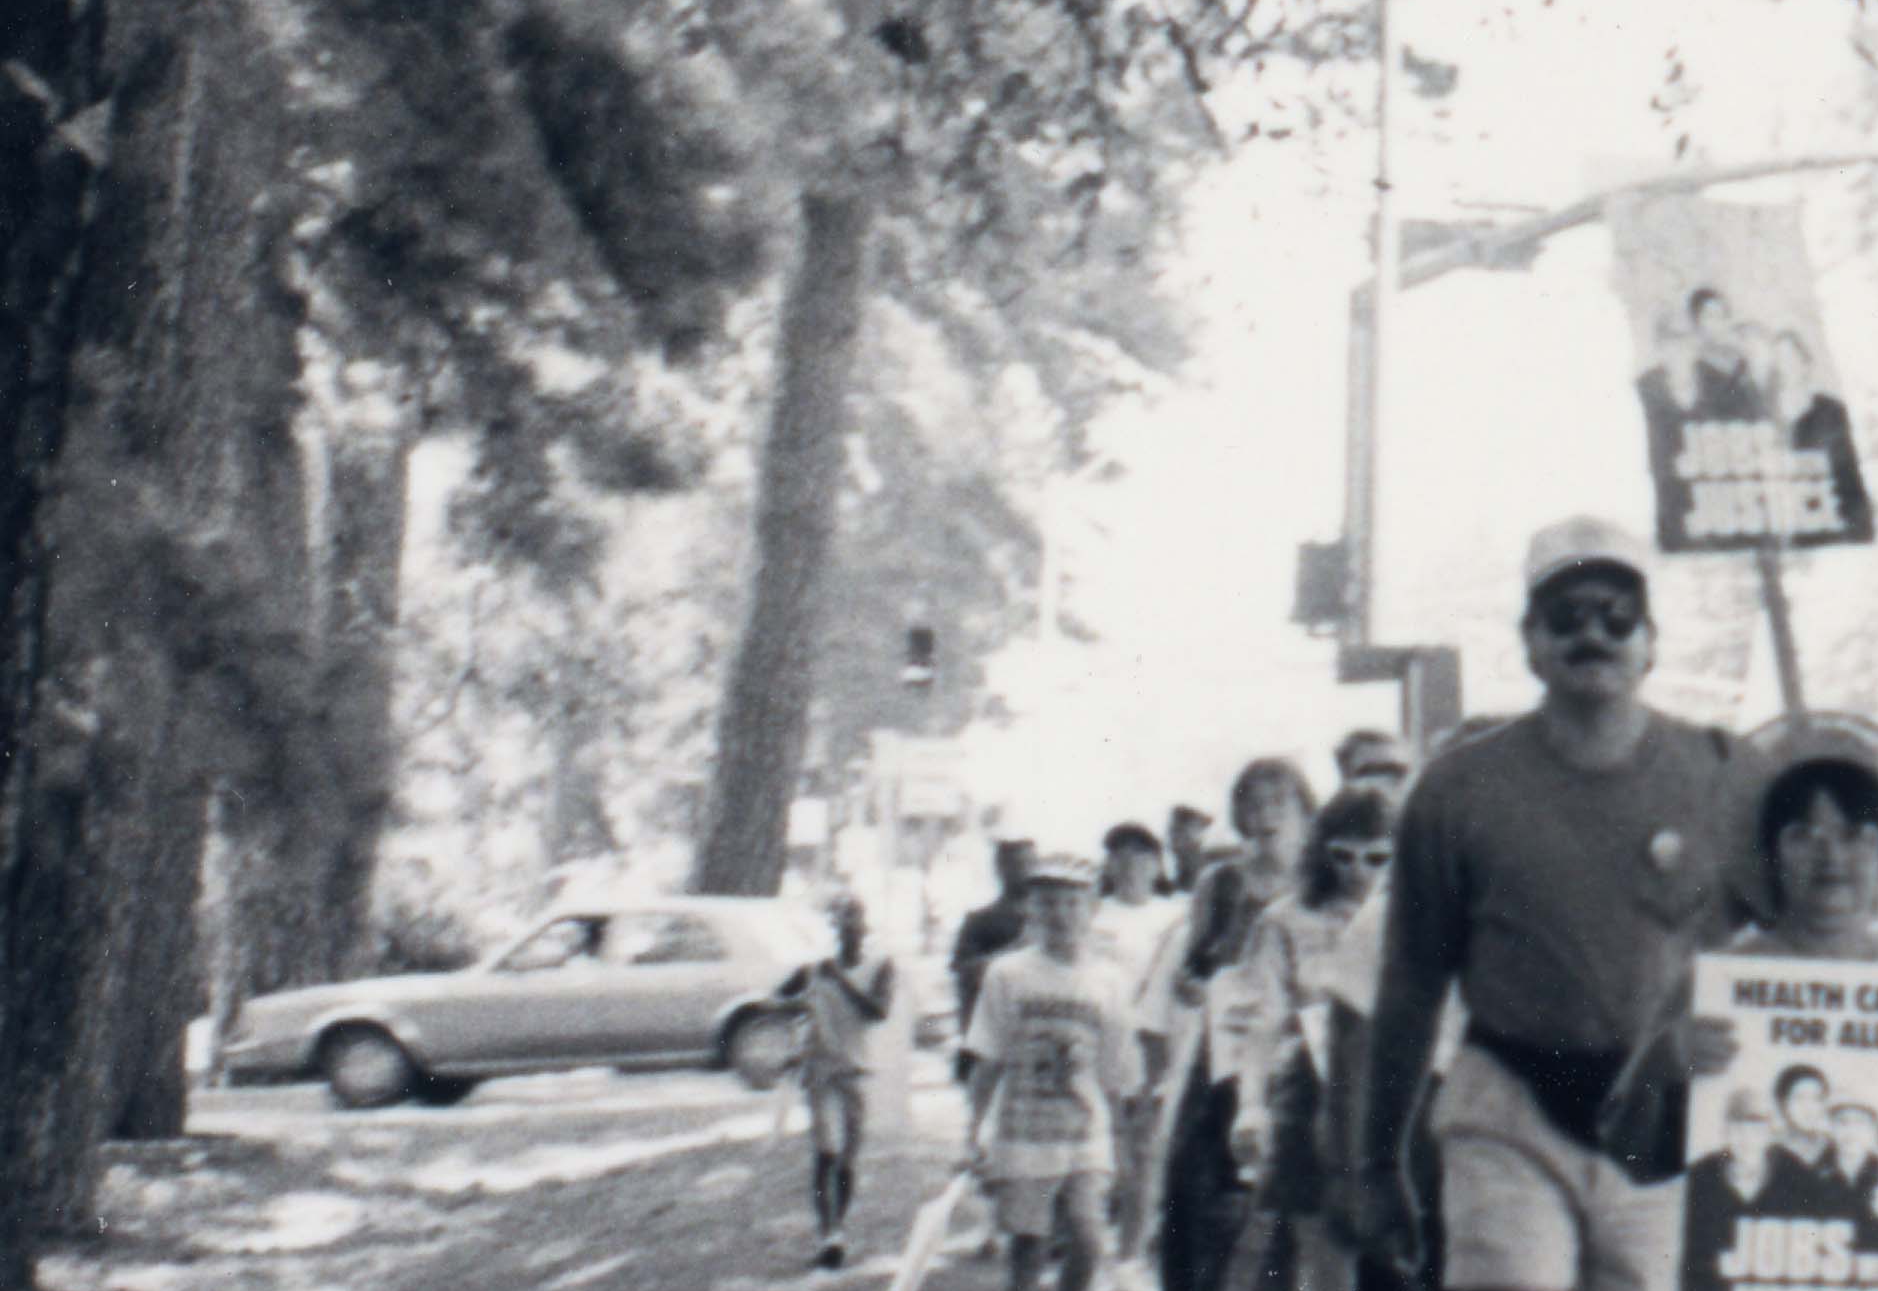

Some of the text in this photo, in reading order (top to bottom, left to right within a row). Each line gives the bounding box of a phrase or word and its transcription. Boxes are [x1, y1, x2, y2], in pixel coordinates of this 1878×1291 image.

[1733, 979, 1846, 1011] HEALTH
[1771, 1016, 1827, 1046] FOR
[1717, 1216, 1856, 1280] JOBS
